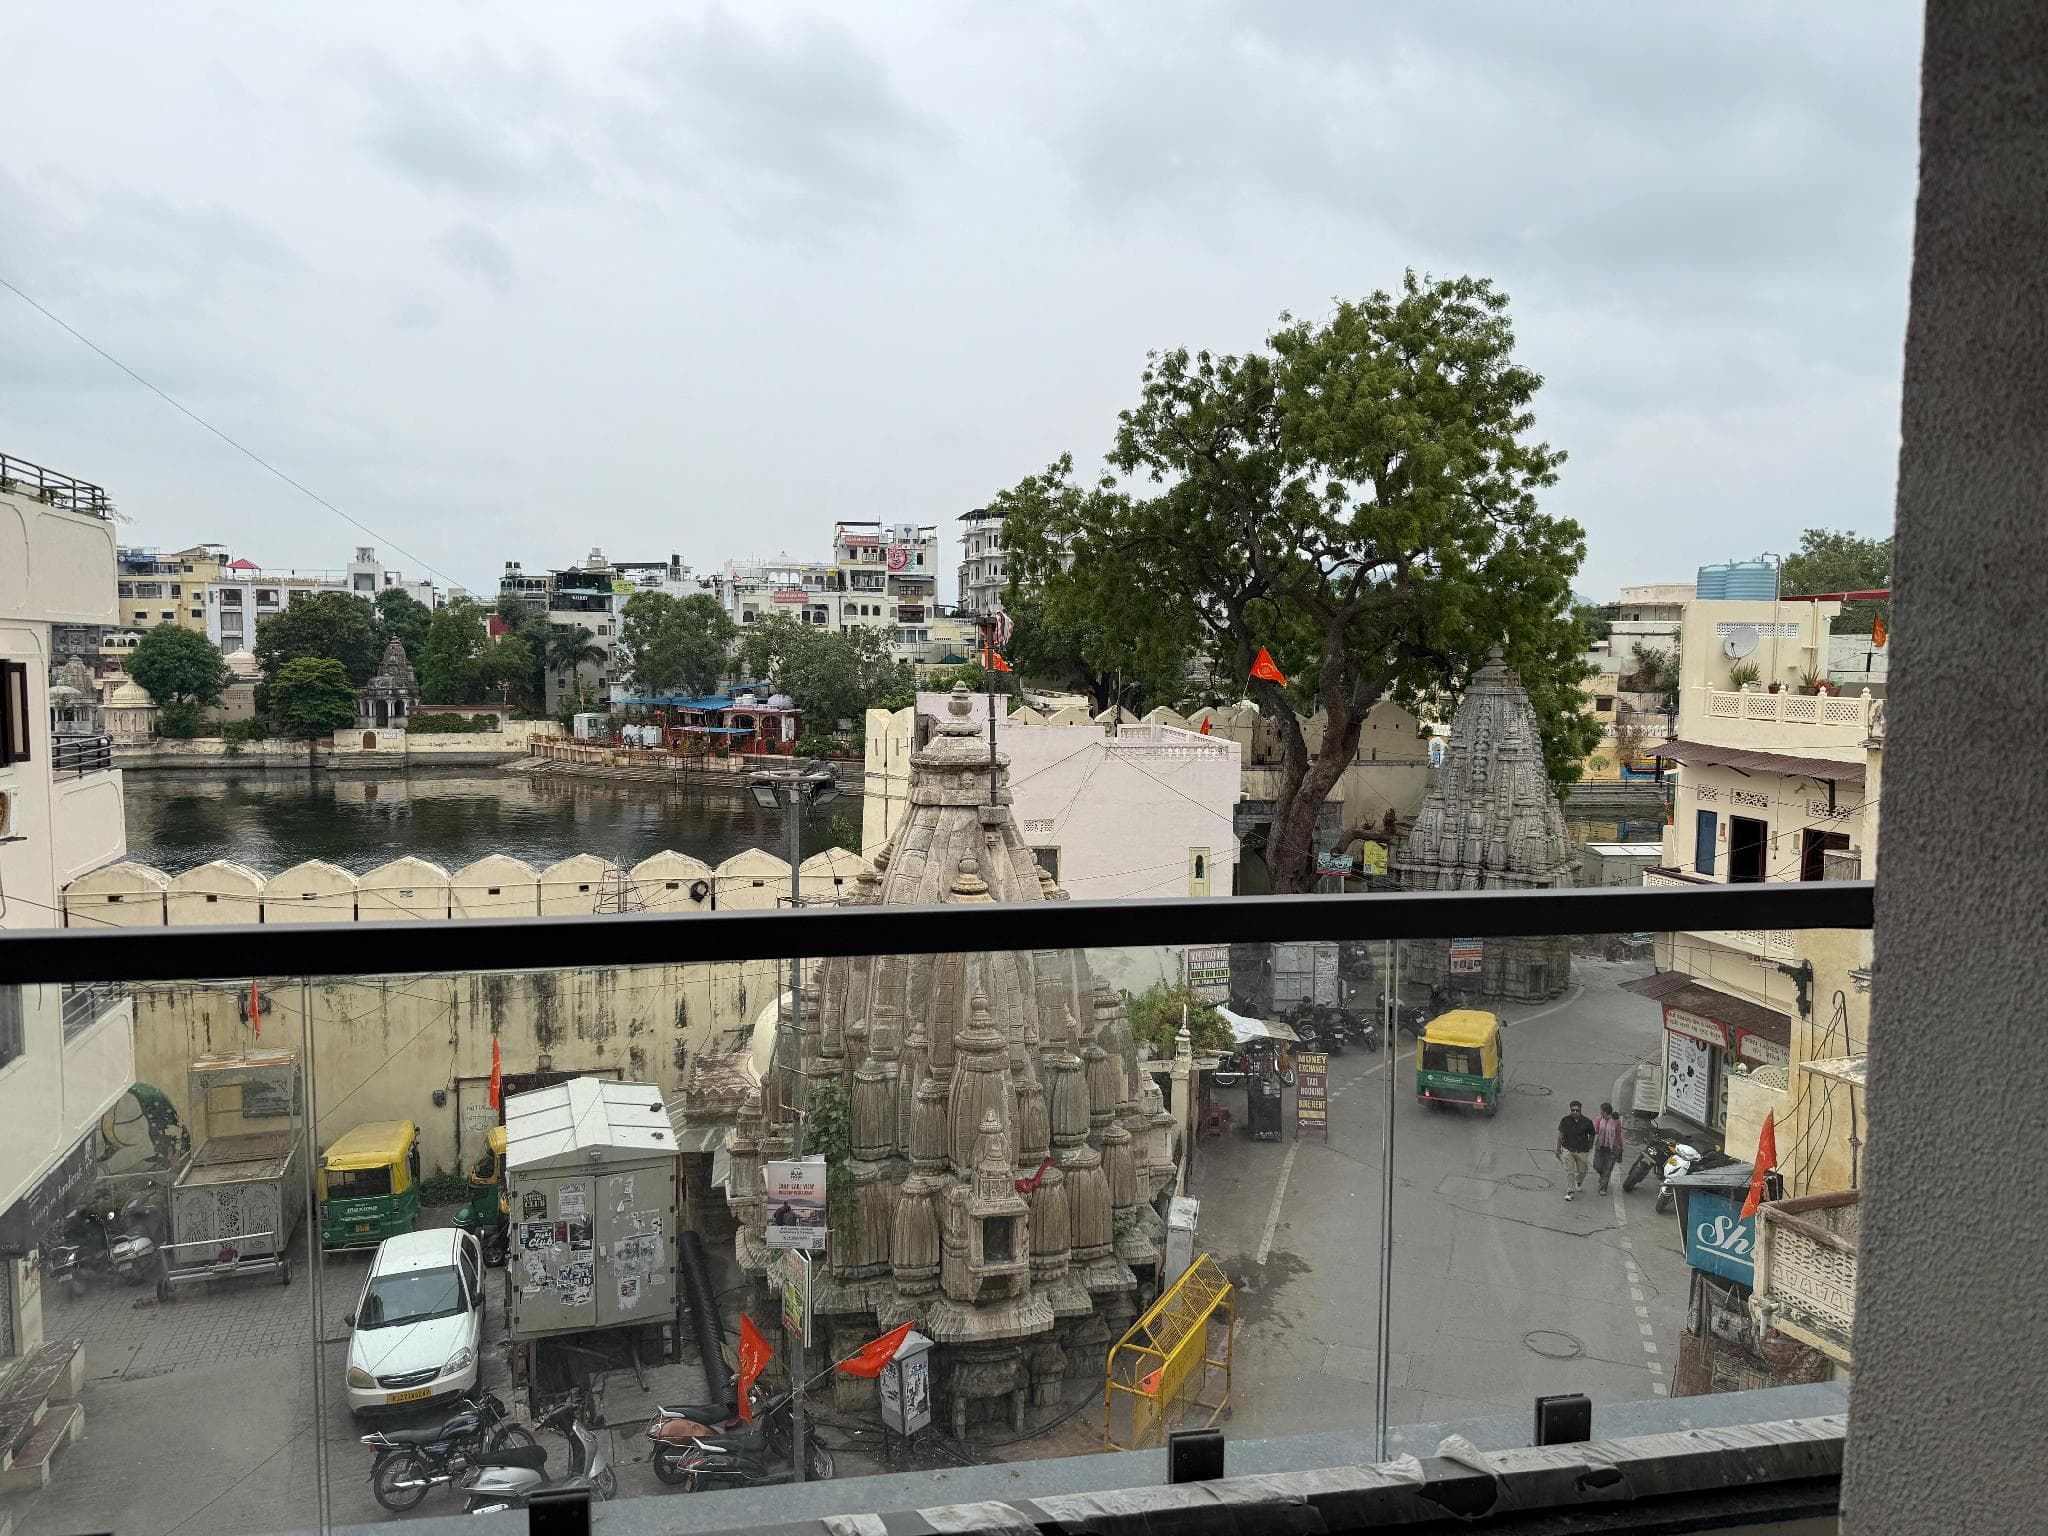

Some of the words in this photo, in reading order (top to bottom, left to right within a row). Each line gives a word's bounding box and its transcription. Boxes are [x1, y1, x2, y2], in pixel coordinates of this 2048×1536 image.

[1298, 1055, 1326, 1064] MONEY
[1298, 1064, 1327, 1074] EXCHANGE
[1307, 1077, 1318, 1086] TAXI
[1300, 1087, 1324, 1096] BOOKING
[1299, 1100, 1311, 1108] BIKE
[1312, 1101, 1326, 1109] RENT
[528, 1237, 554, 1248] Club
